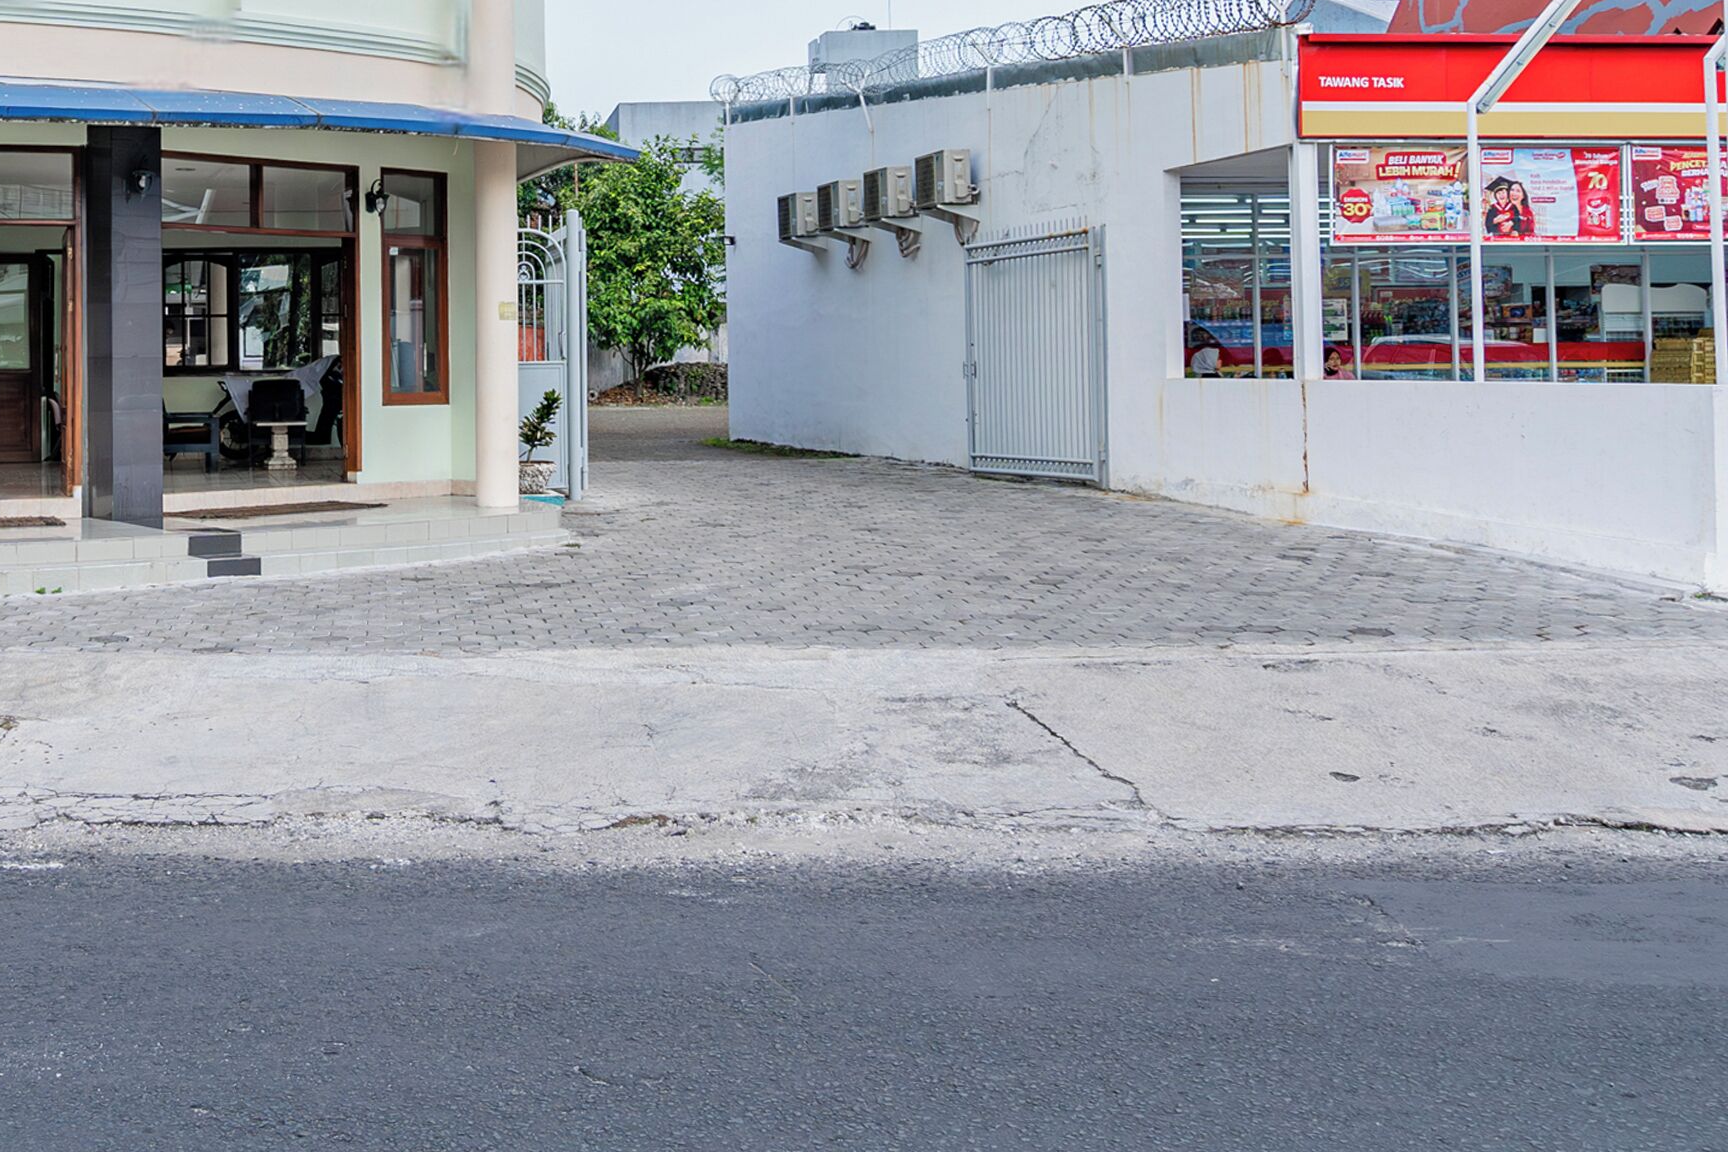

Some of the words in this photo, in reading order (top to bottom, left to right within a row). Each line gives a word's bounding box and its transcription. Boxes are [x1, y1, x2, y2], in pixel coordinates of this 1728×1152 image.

[1318, 75, 1370, 88] TAWANG
[1372, 76, 1405, 89] TASIK
[1388, 155, 1408, 165] BELI
[1408, 154, 1445, 165] BANYAK
[1378, 166, 1411, 177] LEBIH
